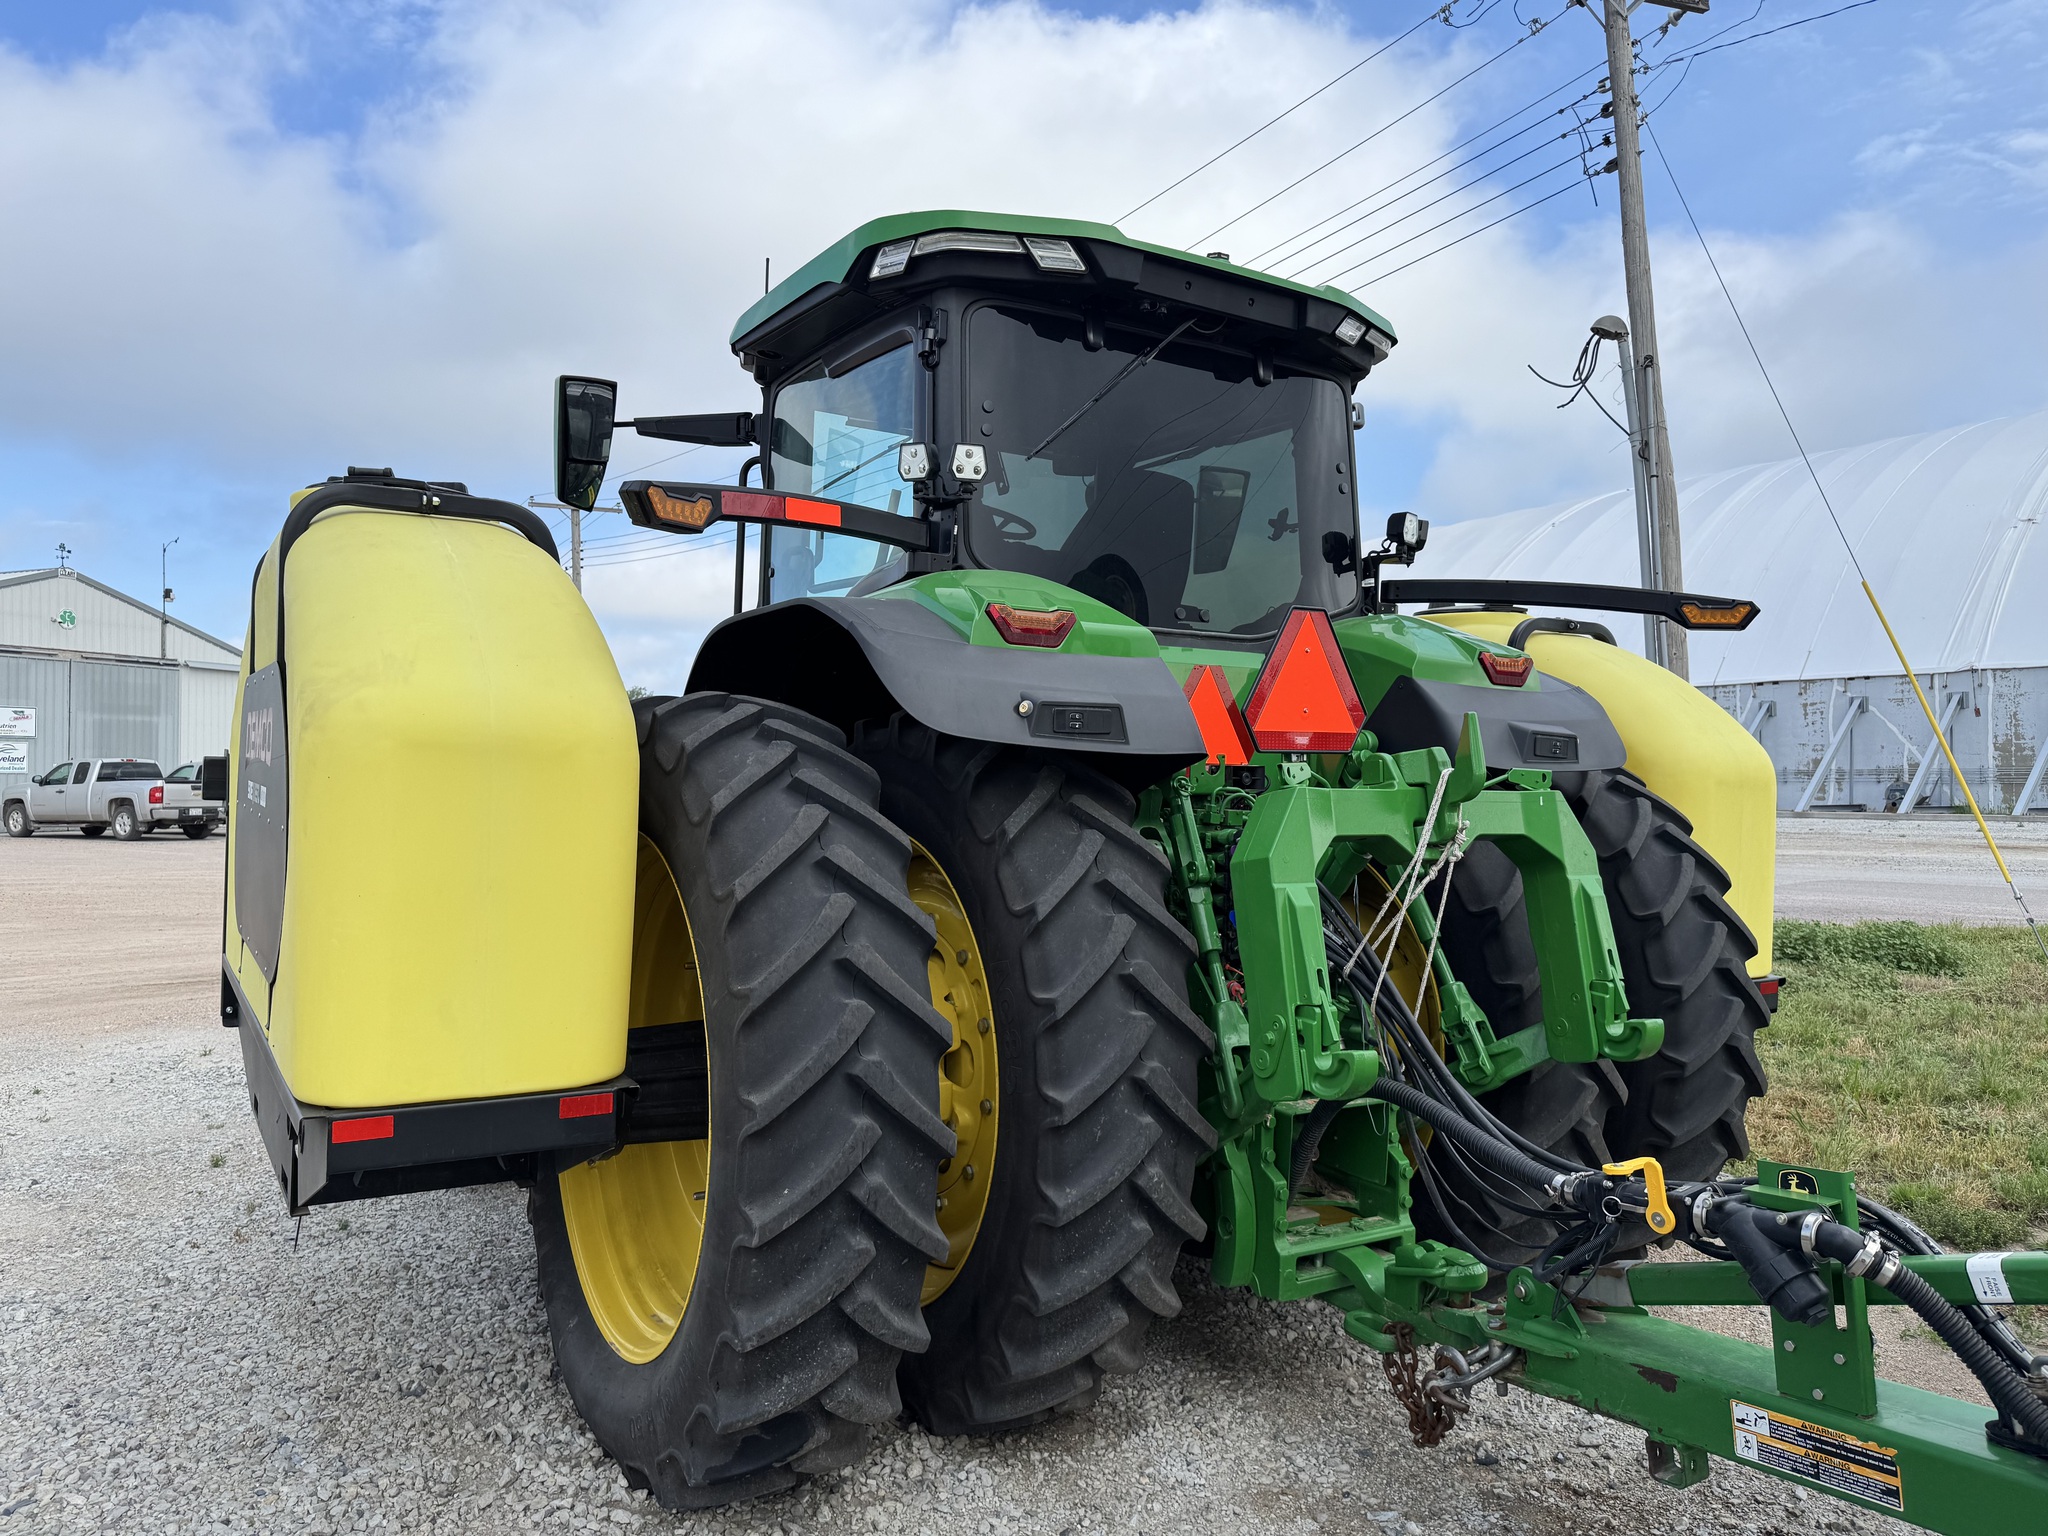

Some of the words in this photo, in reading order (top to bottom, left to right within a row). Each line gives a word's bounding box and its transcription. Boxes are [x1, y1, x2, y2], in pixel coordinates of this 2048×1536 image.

[245, 707, 273, 767] DEMCO
[1807, 1422, 1847, 1441] WARNING
[1810, 1453, 1851, 1471] WARNING
